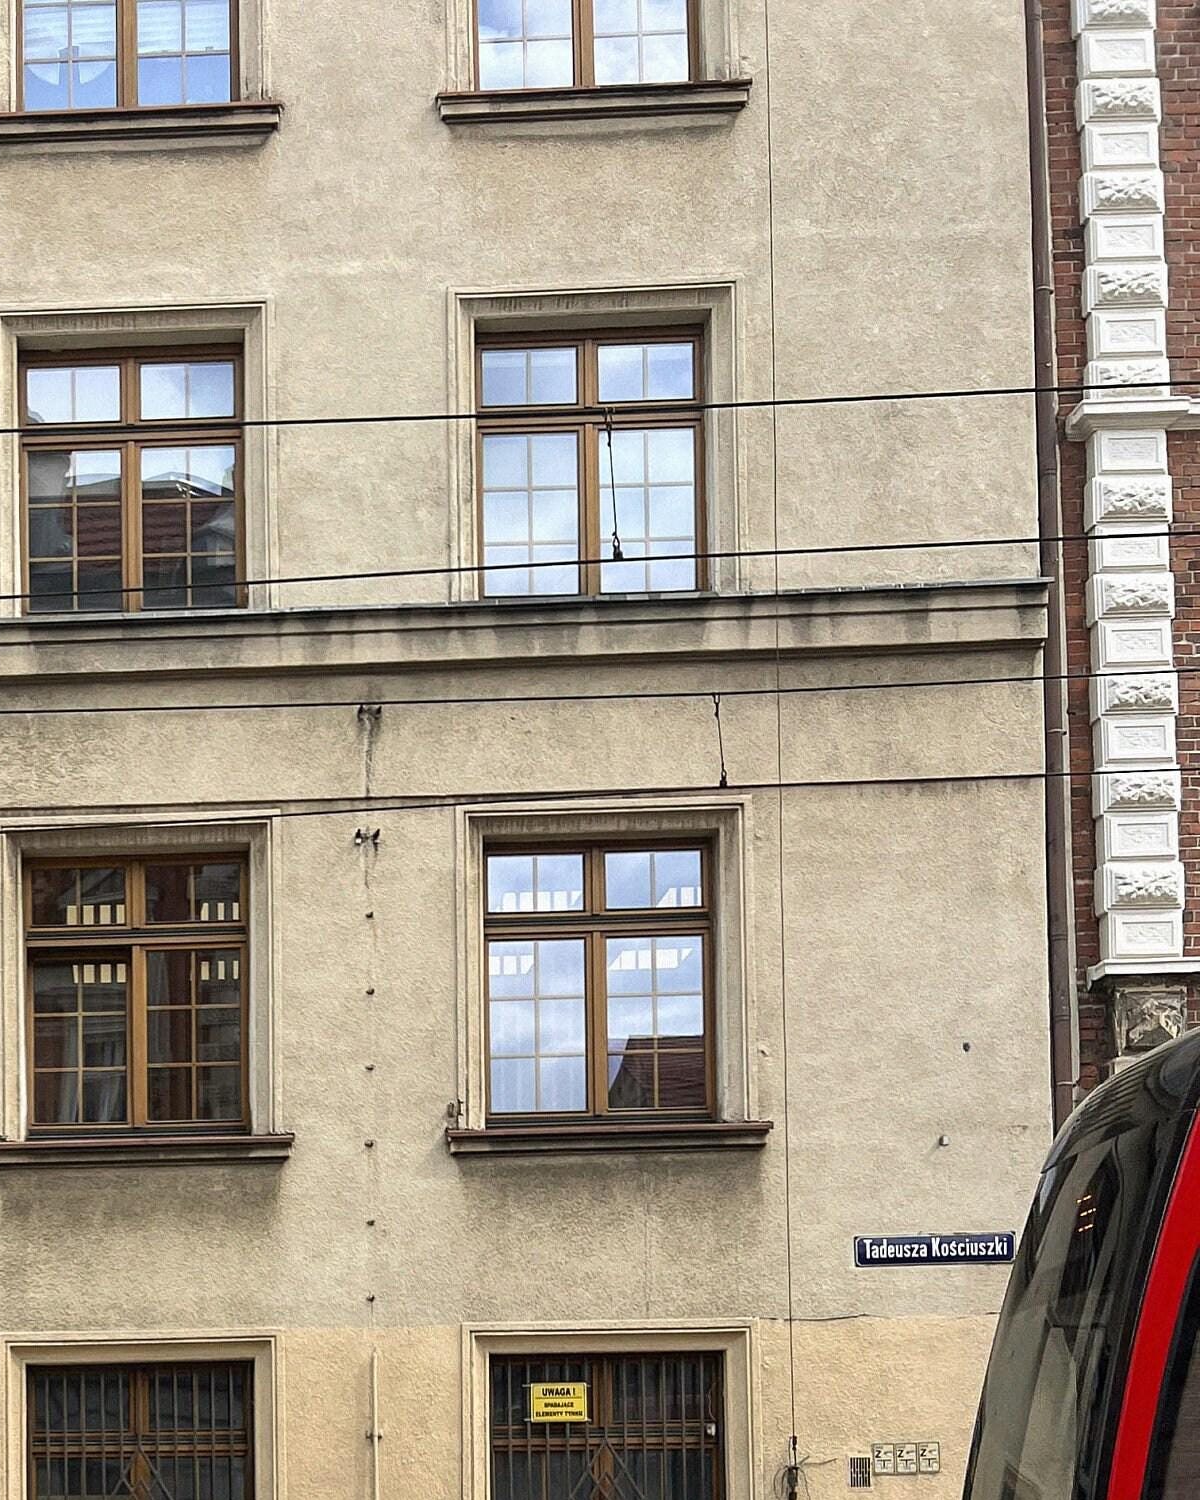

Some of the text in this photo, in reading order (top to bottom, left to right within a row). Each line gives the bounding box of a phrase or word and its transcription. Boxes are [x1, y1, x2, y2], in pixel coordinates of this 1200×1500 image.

[863, 1236, 1008, 1259] Tadeusza Kościuszki
[542, 1387, 571, 1396] UWAGA
